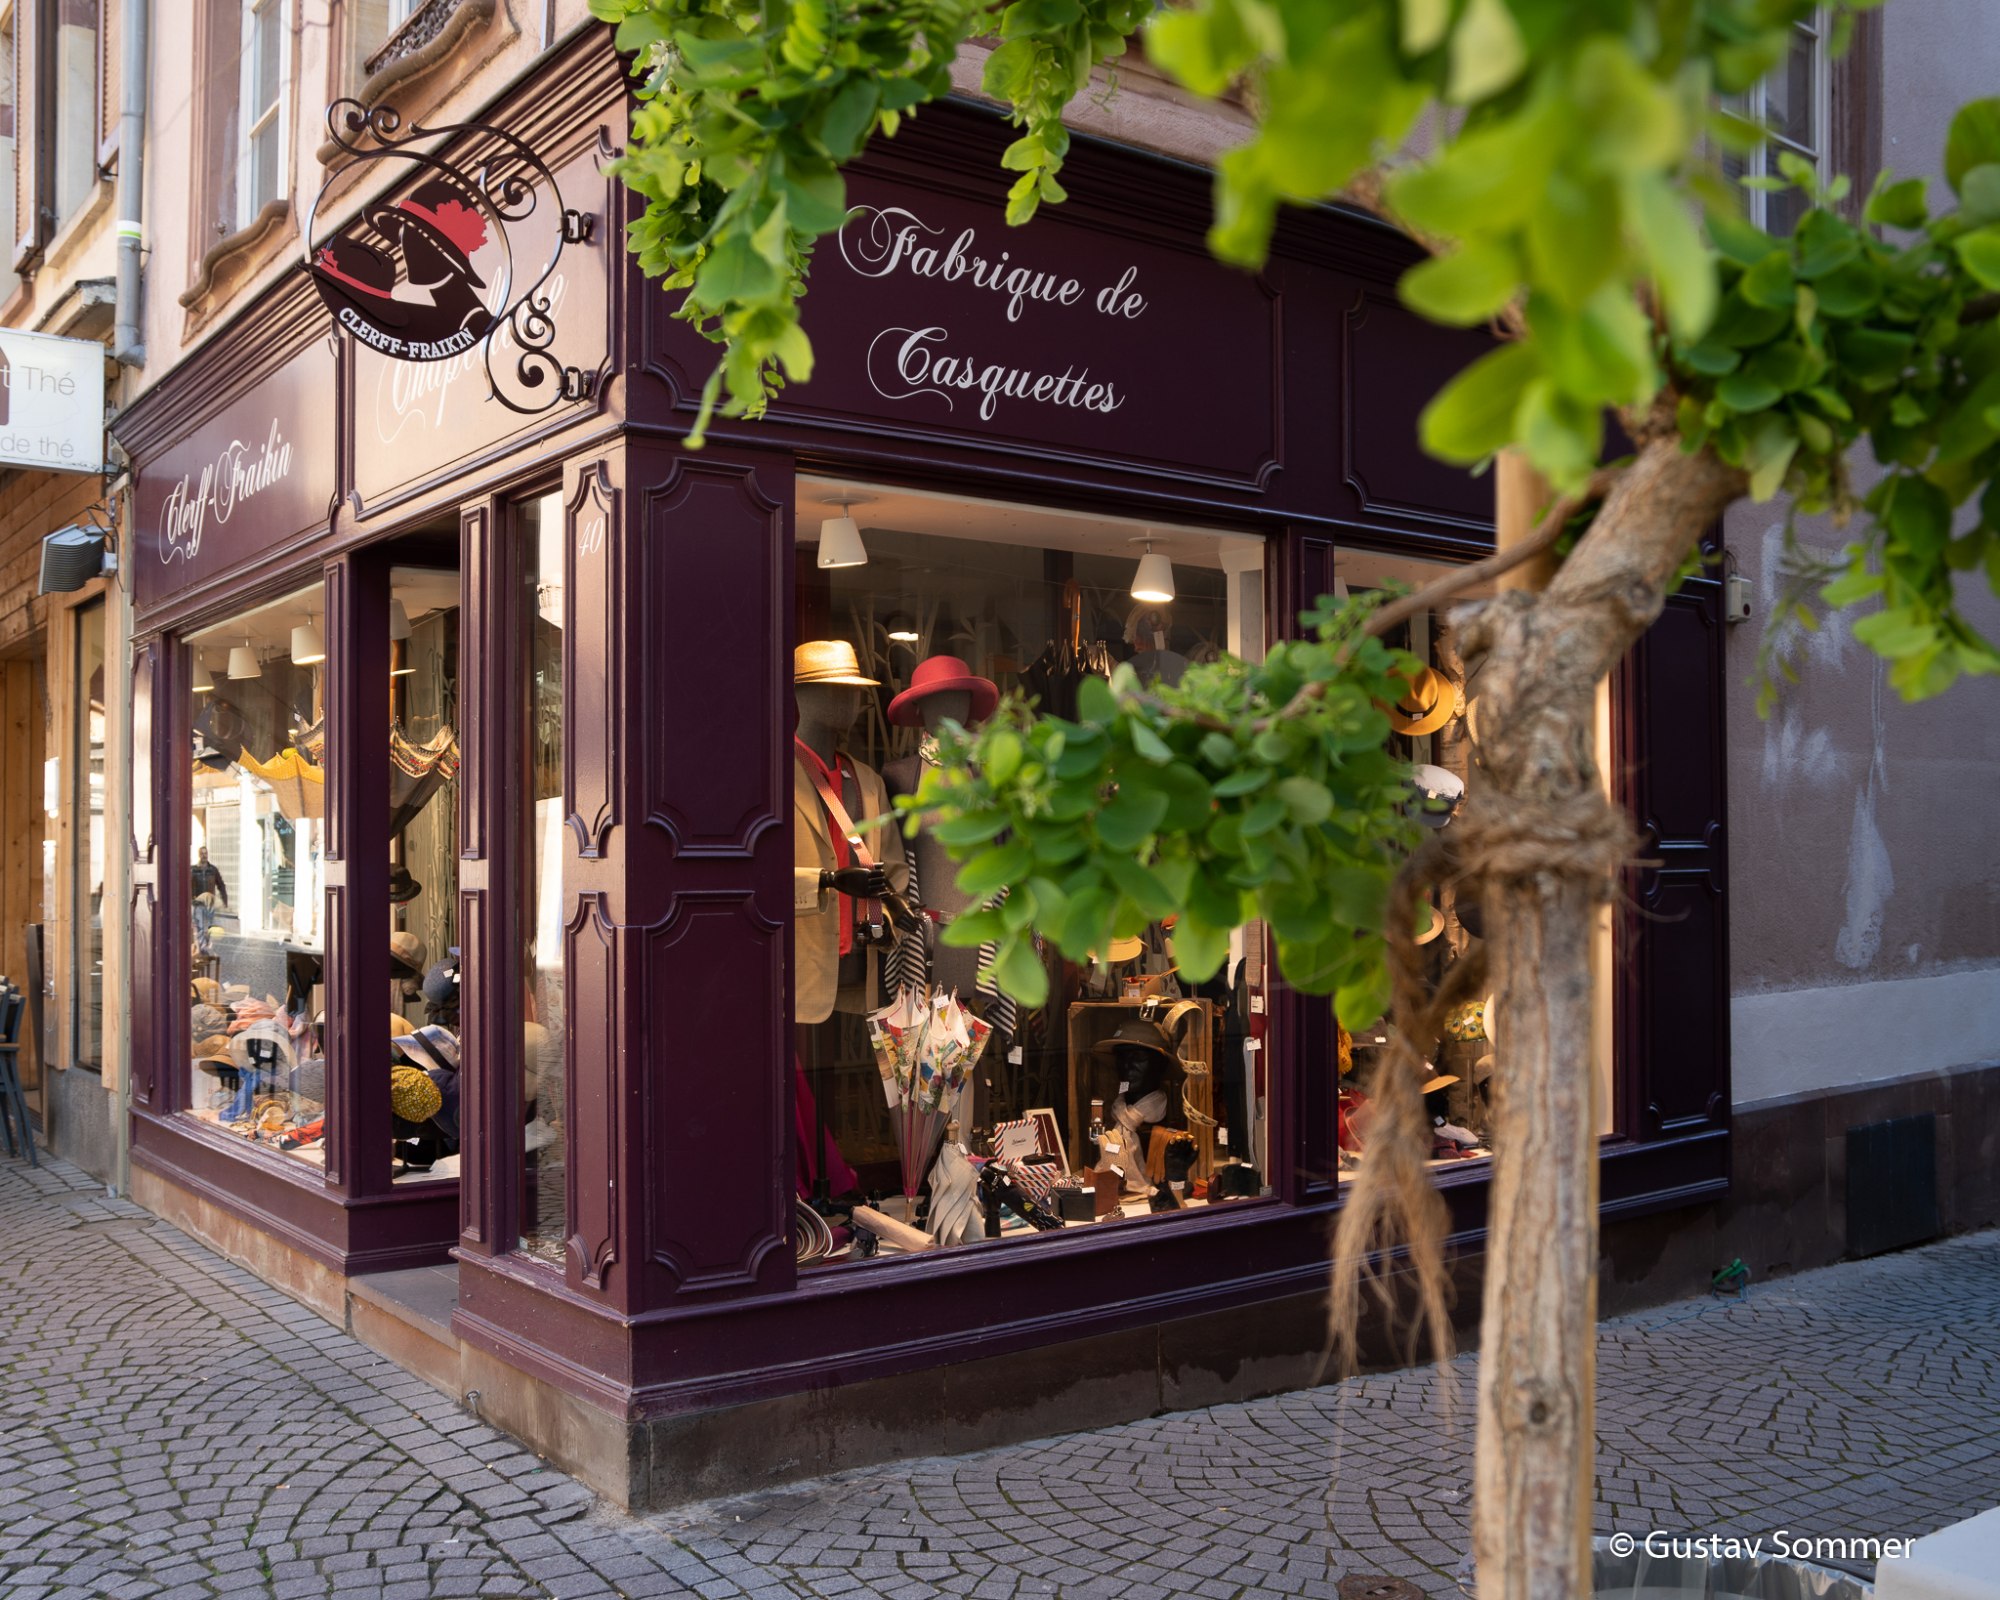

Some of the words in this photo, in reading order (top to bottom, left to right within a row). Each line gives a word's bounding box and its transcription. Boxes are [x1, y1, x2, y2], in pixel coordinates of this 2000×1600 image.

[839, 205, 1085, 322] Fabrique
[1096, 266, 1148, 319] de
[339, 307, 476, 360] CLERFF-FRAIKIN
[20, 366, 75, 395] Thé
[867, 326, 1126, 421] Casquettes
[0, 433, 30, 454] de
[38, 436, 75, 459] thé
[158, 417, 294, 566] Clerff-Fraikin
[578, 517, 604, 558] 40
